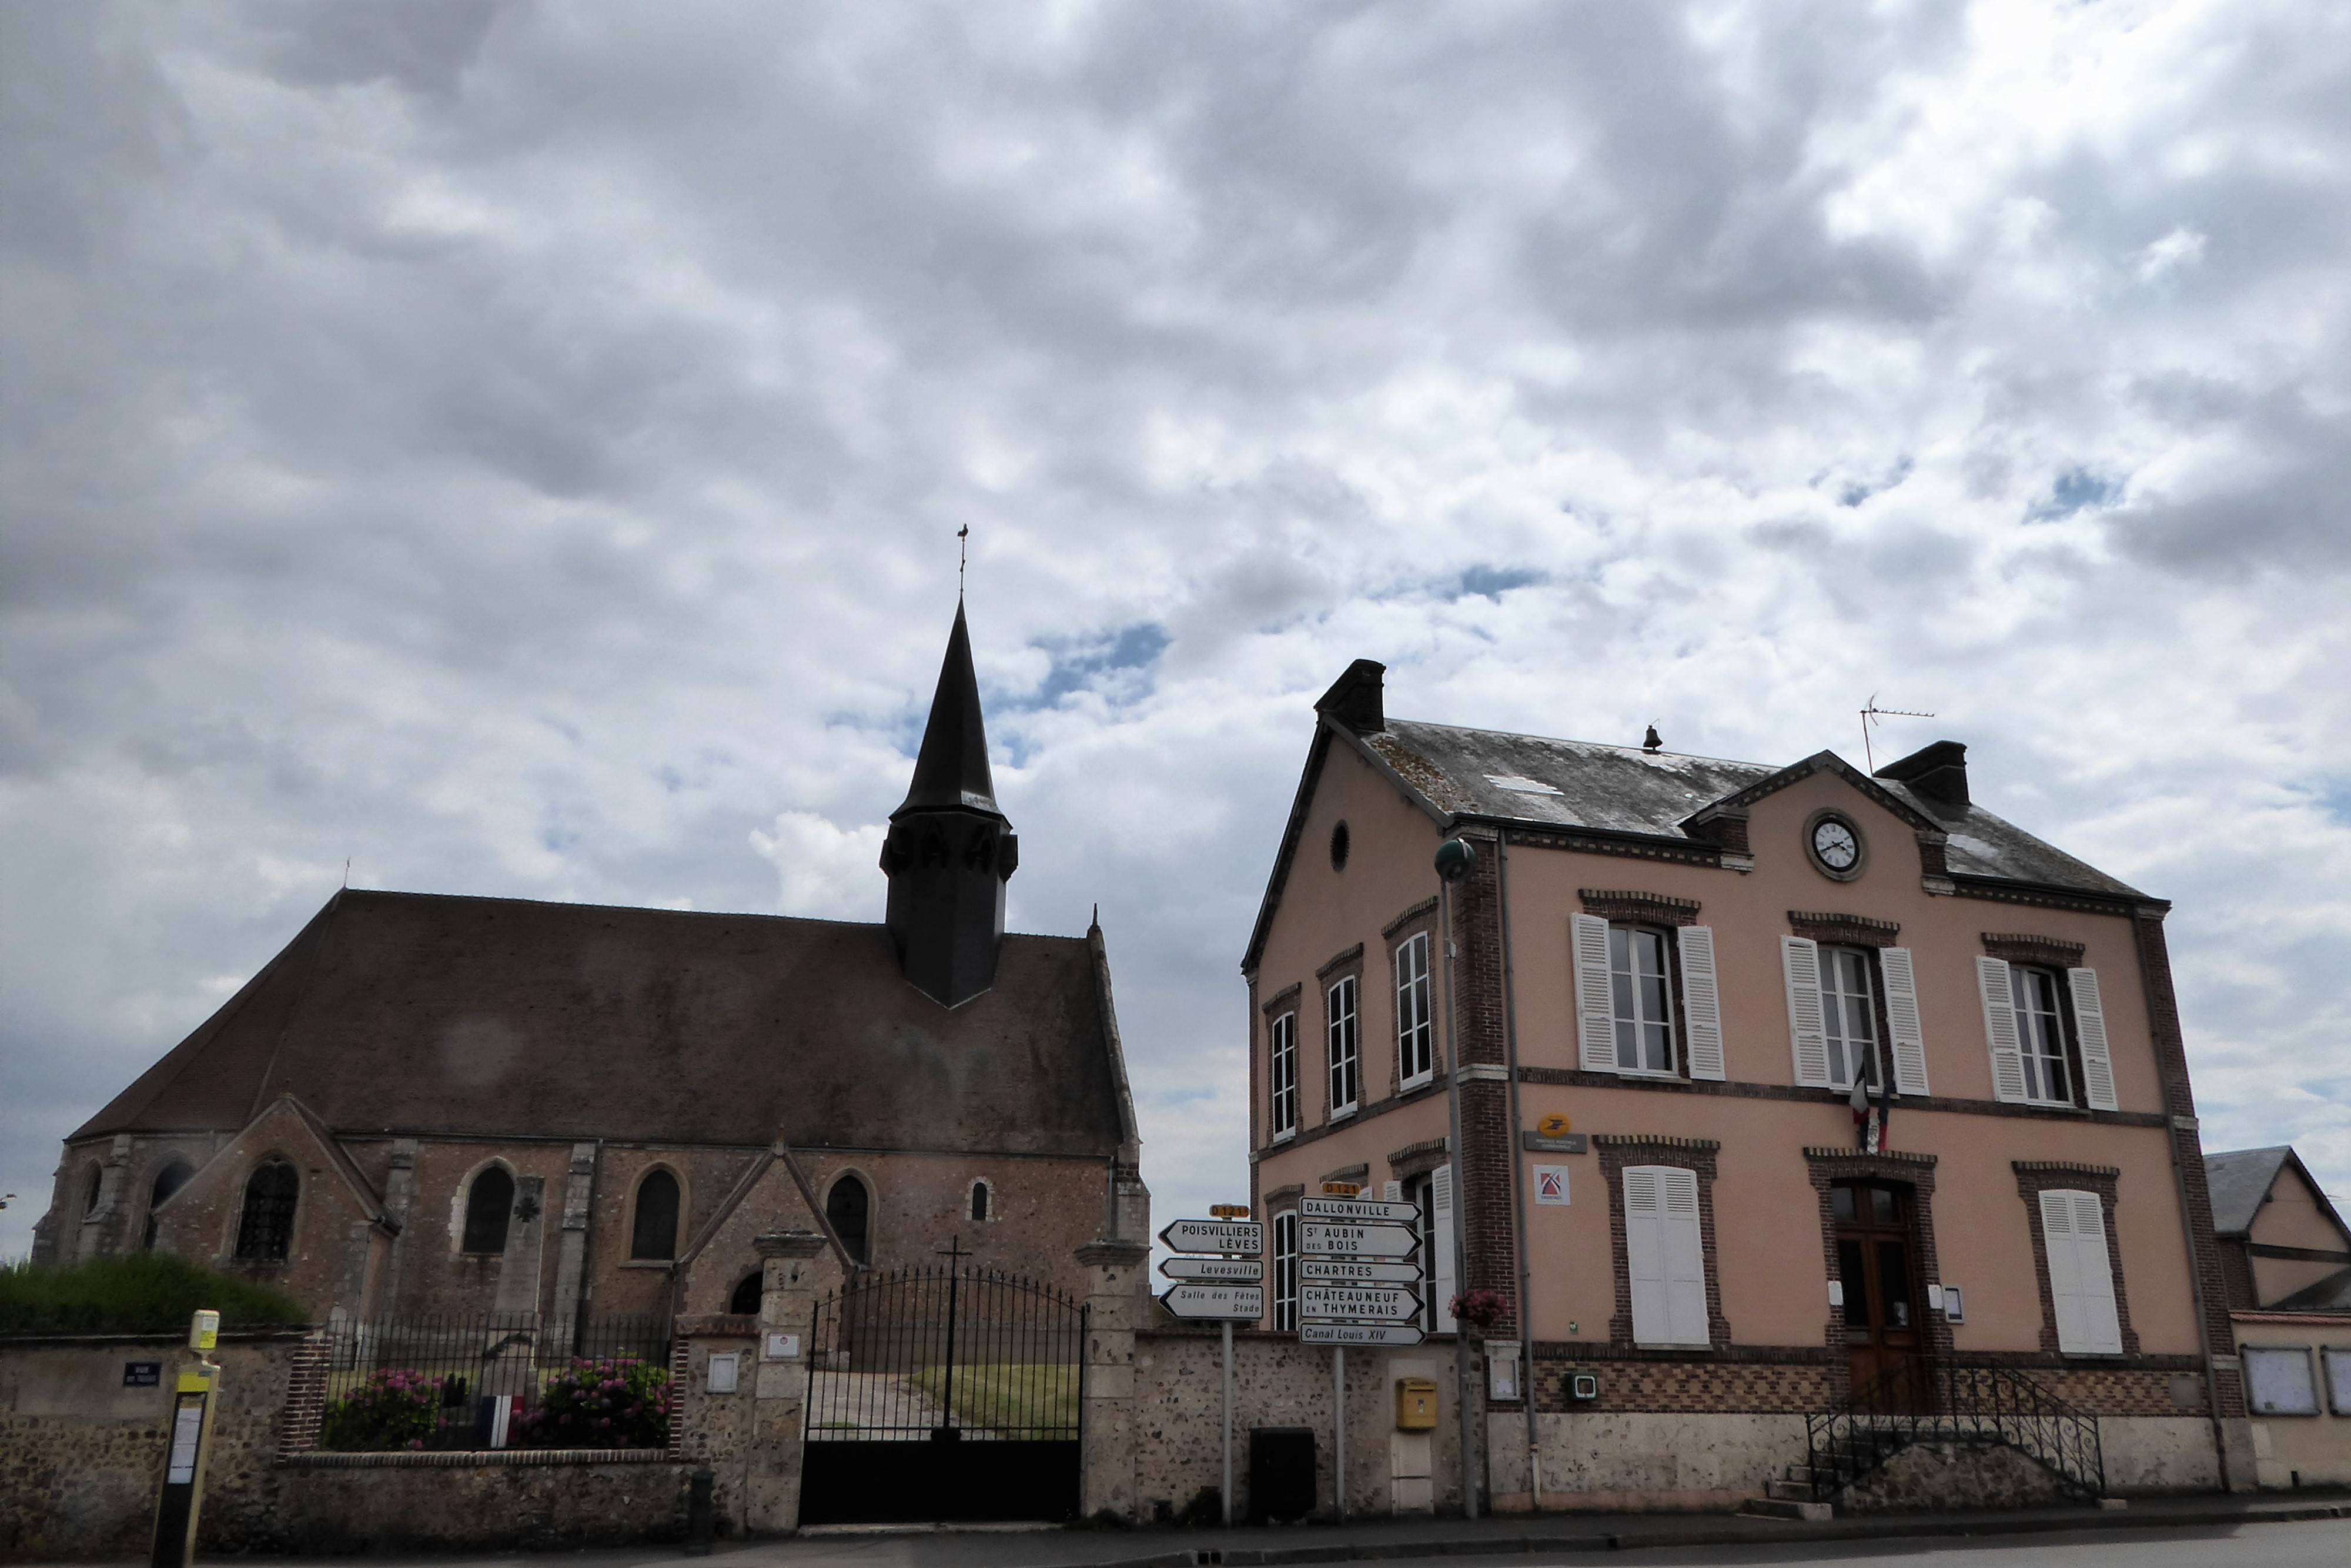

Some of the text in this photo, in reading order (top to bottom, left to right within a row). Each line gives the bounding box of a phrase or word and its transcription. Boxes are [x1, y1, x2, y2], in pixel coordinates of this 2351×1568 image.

[1306, 1202, 1390, 1216] DALLONVILLE
[1182, 1225, 1259, 1237] POISVILLIERS
[1325, 1228, 1364, 1239] AUBIN
[1327, 1241, 1358, 1251] BOIS
[1306, 1265, 1372, 1277] CHARTRES
[1180, 1290, 1205, 1299] Salle
[1212, 1292, 1228, 1300] des
[1306, 1288, 1399, 1303] CHÂTEAUNEUF
[1233, 1303, 1260, 1313] Stade
[1323, 1303, 1398, 1316] THYMERAIS
[1305, 1328, 1386, 1340] Canal Louis XIV
